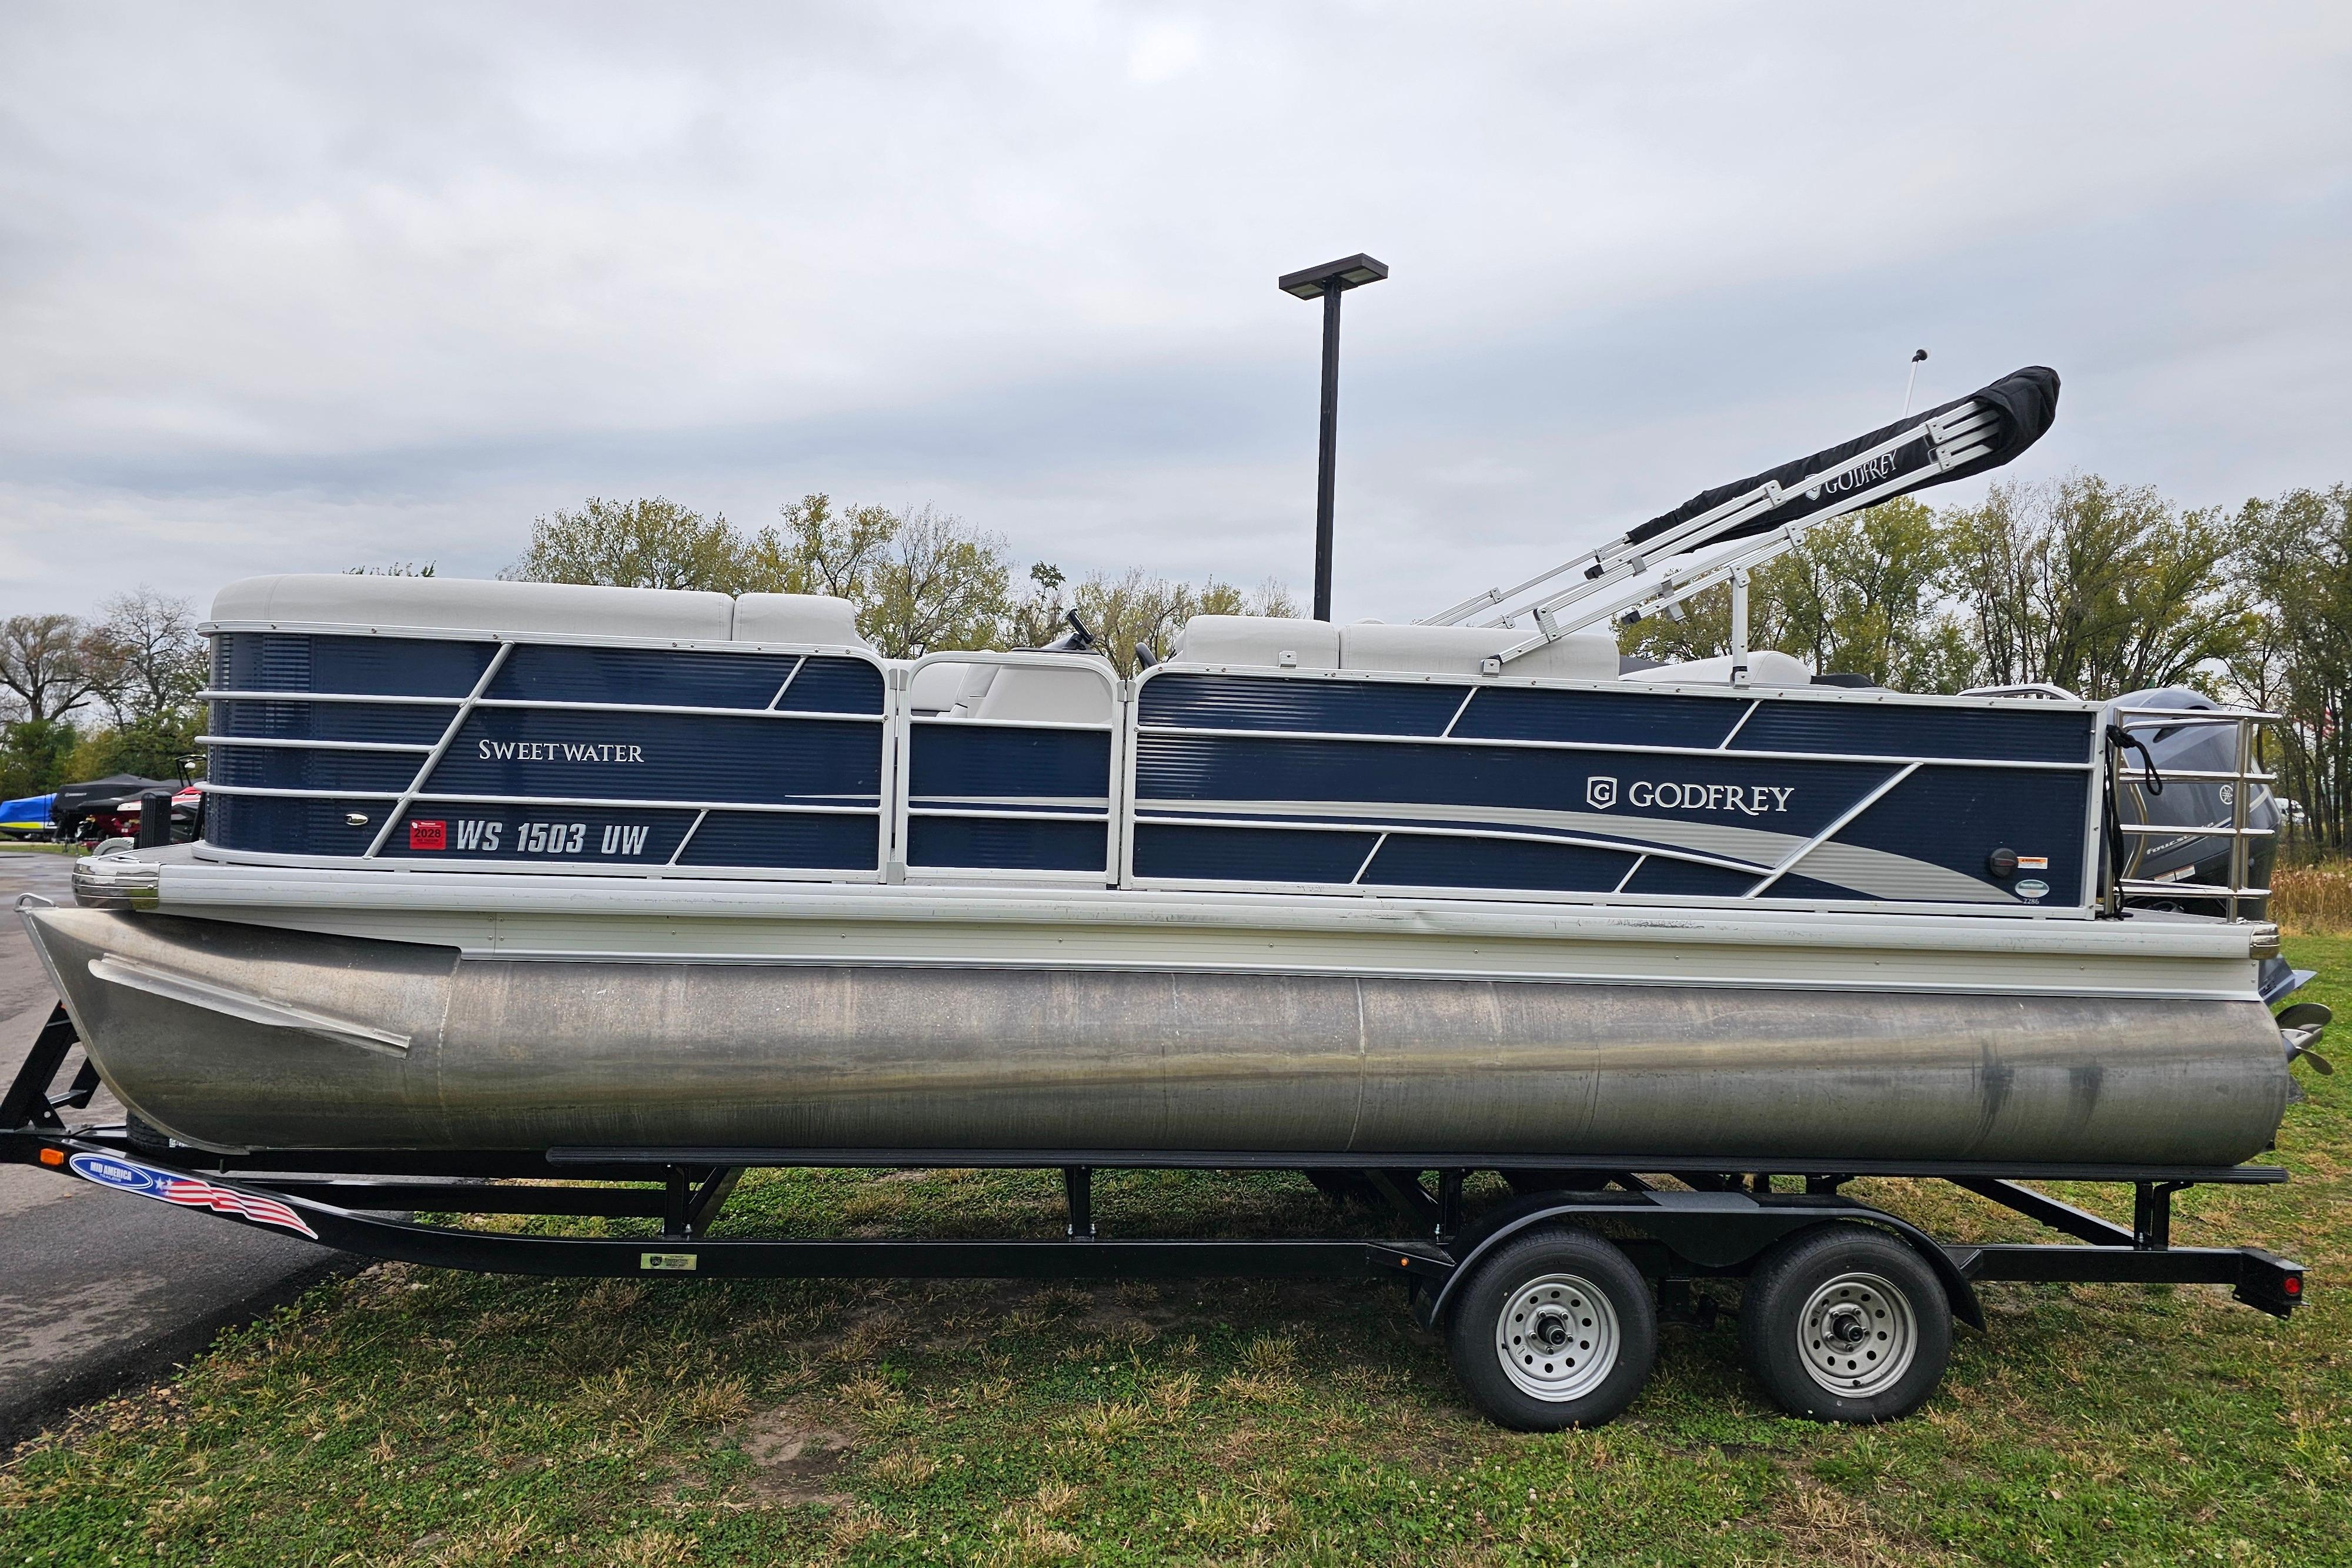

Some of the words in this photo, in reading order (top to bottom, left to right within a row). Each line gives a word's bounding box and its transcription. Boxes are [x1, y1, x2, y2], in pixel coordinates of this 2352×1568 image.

[1825, 449, 1897, 494] GODFREY
[1629, 781, 1795, 816] GODFREY
[414, 828, 441, 838] 2028
[457, 820, 503, 851] WS
[517, 823, 587, 853] 1503
[601, 825, 650, 855] UW
[90, 1161, 103, 1174] MID
[103, 1165, 132, 1182] AMERICA
